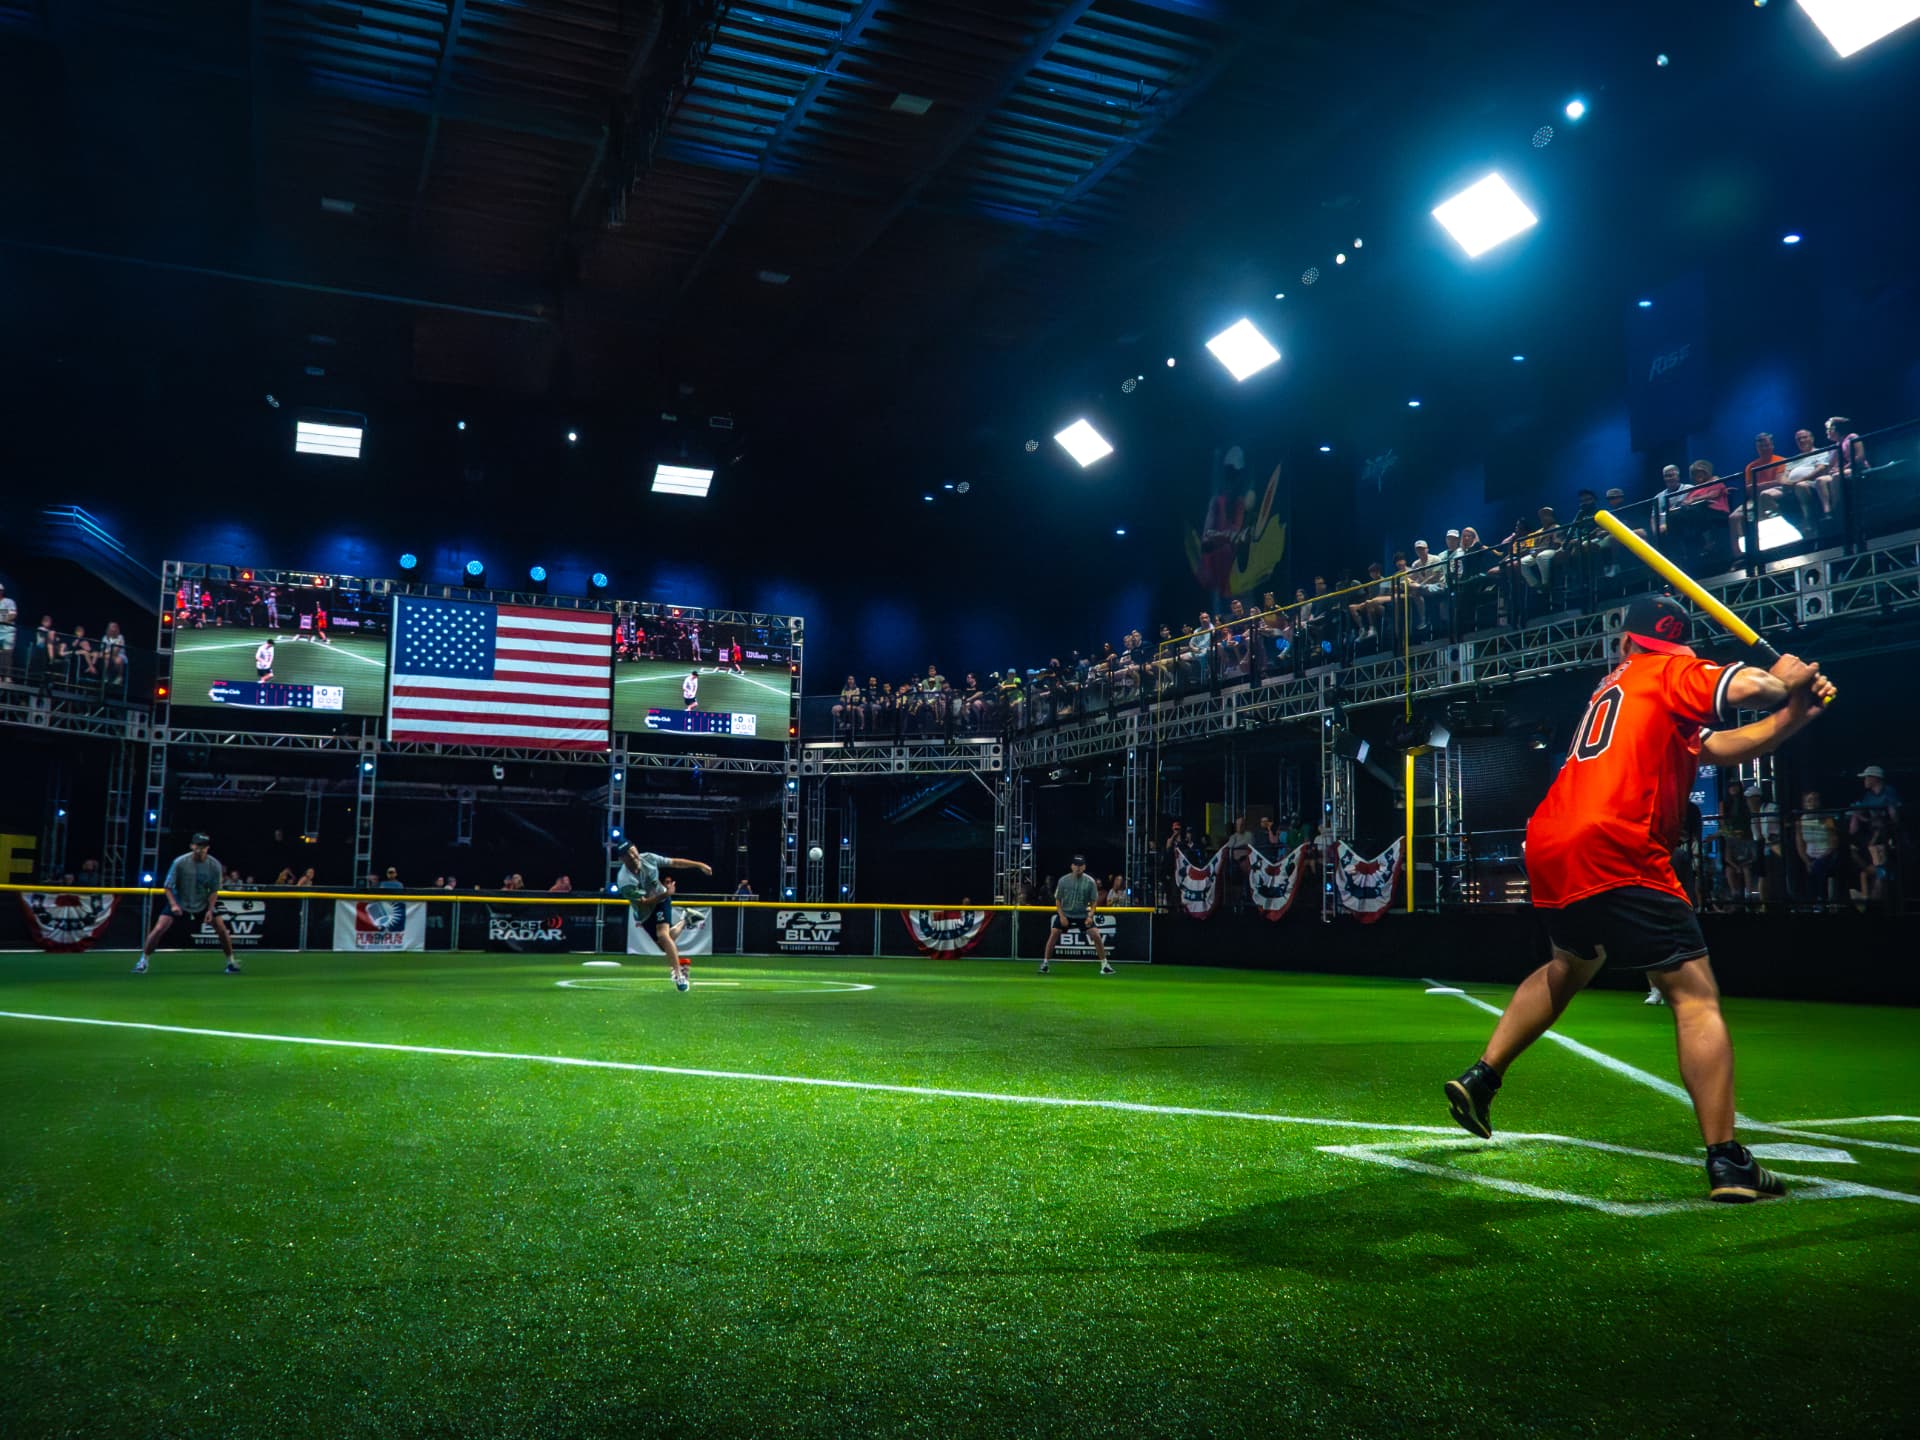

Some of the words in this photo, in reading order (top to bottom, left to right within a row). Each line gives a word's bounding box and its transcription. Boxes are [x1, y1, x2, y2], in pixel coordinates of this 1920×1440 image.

[745, 650, 769, 660] Wilson
[490, 919, 543, 929] POCKET
[785, 929, 832, 941] BLW
